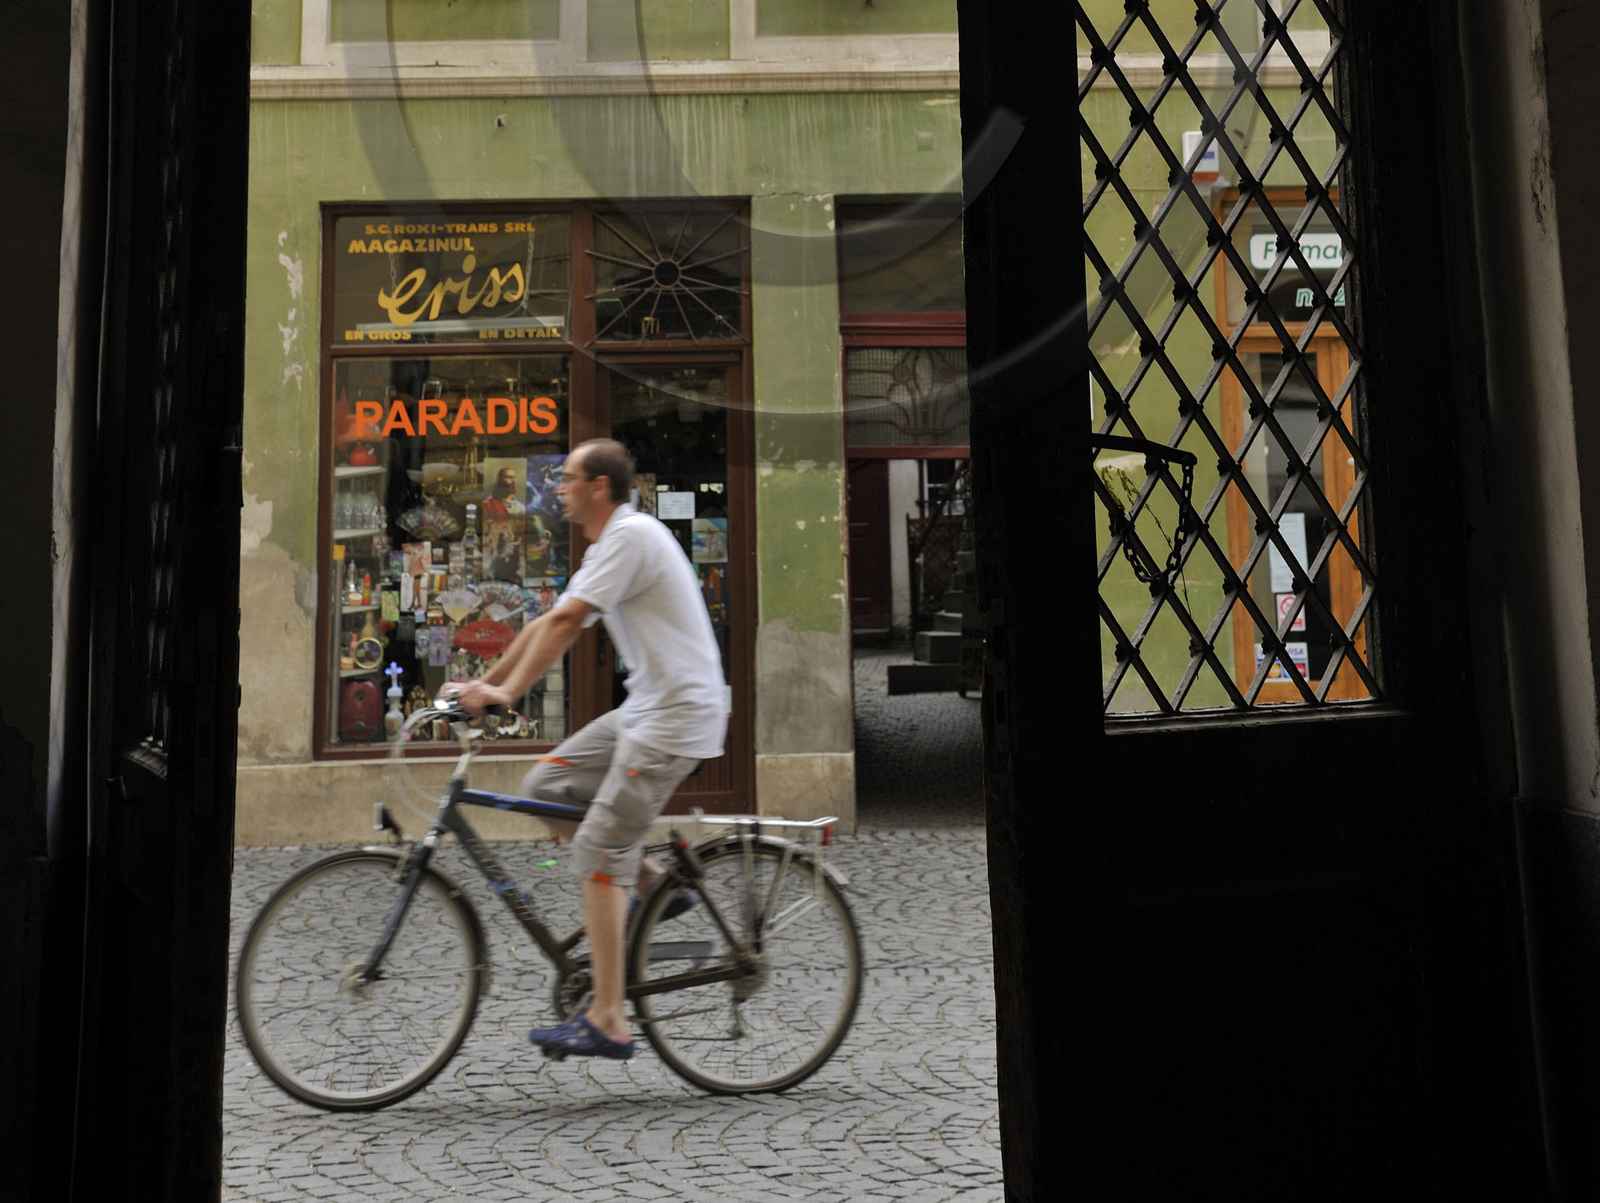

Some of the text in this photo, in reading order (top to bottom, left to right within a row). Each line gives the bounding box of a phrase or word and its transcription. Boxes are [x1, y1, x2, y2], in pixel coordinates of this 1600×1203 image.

[394, 223, 498, 234] ROXI-TRANS
[504, 222, 535, 233] SRL
[347, 237, 474, 253] MAGAZINUL
[345, 327, 561, 341] EN GROS EN DETAIL
[356, 397, 558, 438] PARADIS
